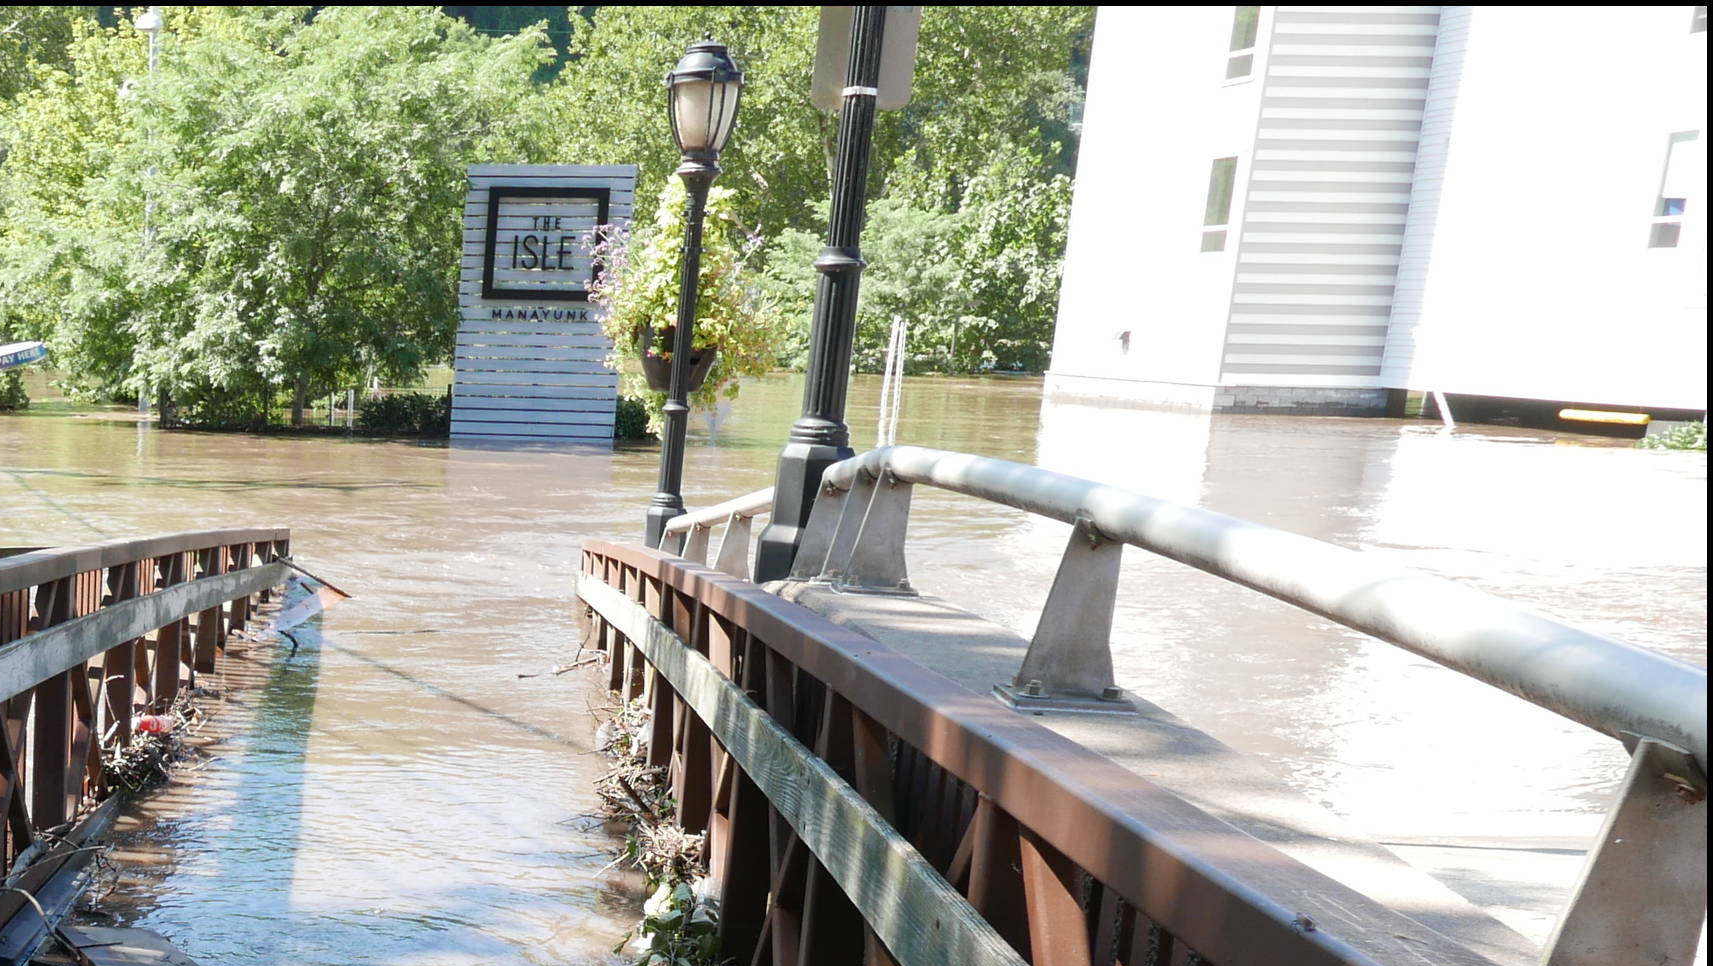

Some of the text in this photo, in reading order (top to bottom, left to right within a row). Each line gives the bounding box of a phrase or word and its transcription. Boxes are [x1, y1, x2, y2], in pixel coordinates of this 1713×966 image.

[533, 217, 561, 229] THE
[513, 235, 575, 270] ISLE
[492, 309, 588, 320] MANAYUNK
[17, 347, 40, 361] HERE
